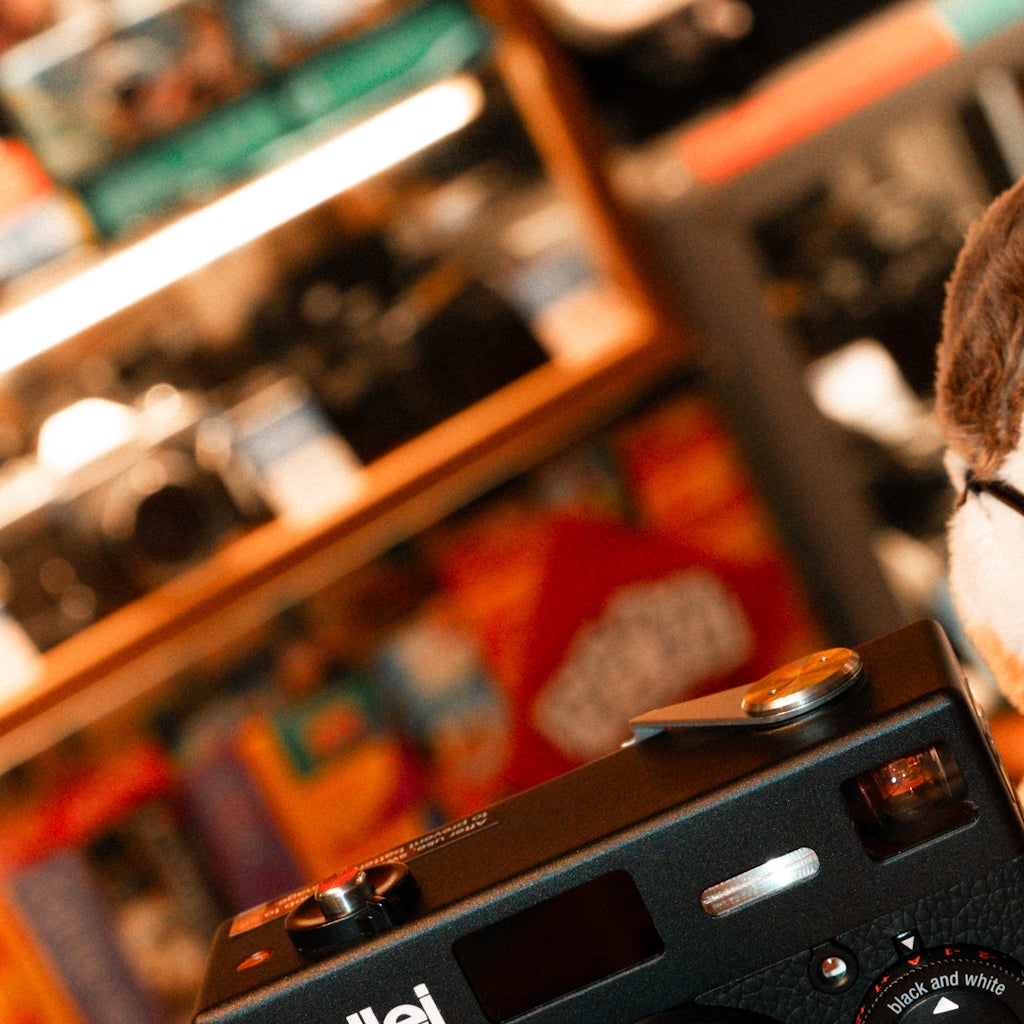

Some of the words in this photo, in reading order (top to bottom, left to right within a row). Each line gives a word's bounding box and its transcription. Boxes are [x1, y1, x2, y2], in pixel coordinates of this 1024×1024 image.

[887, 982, 929, 1015] black
[930, 971, 959, 990] and
[965, 973, 1006, 996] white
